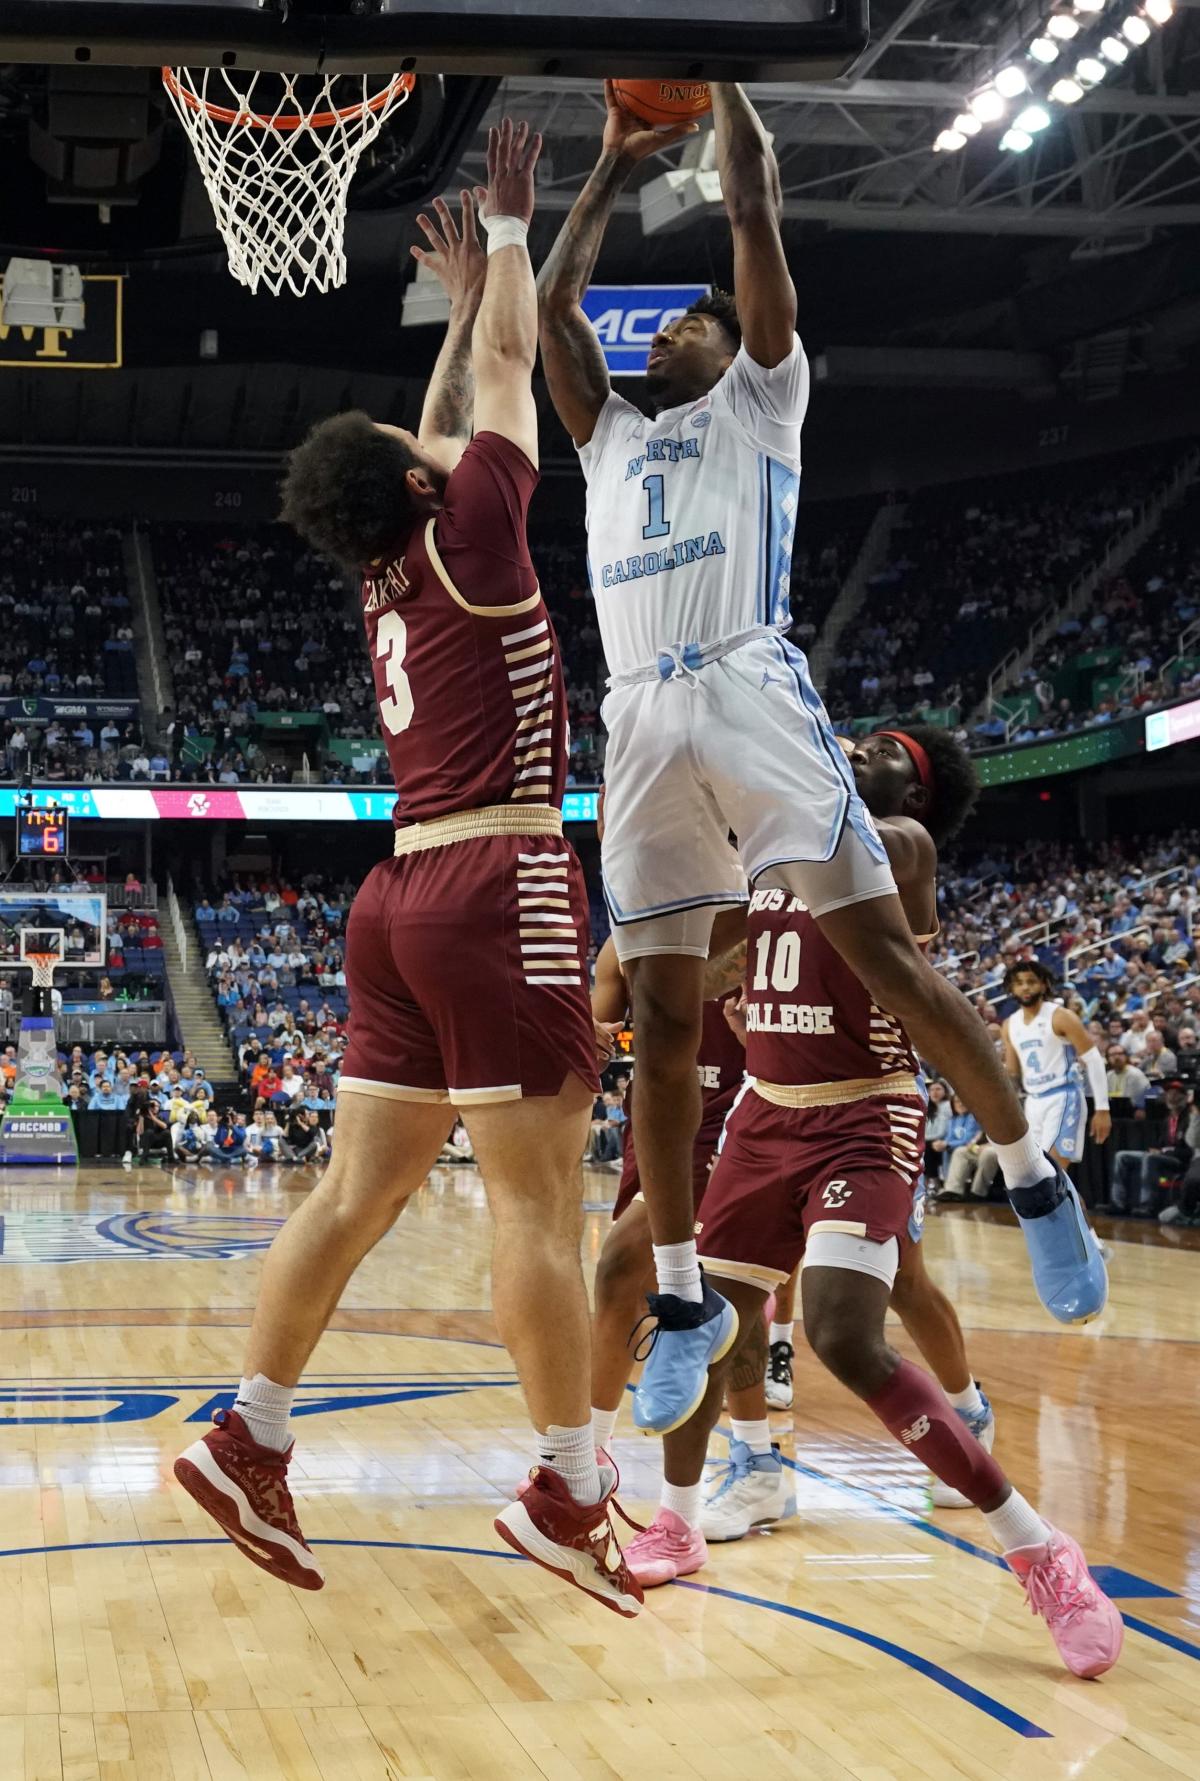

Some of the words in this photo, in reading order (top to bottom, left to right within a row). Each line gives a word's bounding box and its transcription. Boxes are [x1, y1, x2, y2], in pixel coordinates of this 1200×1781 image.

[658, 83, 705, 104] DING
[624, 438, 700, 481] NRTH
[12, 488, 37, 502] 201
[215, 492, 241, 507] 240
[643, 474, 671, 540] 1
[602, 531, 726, 588] CAROLINA
[377, 609, 415, 736] 3
[364, 797, 373, 817] 1
[43, 827, 59, 853] 6
[753, 930, 801, 992] 10
[746, 1002, 836, 1035] OLLEGE
[1026, 1051, 1041, 1073] 4
